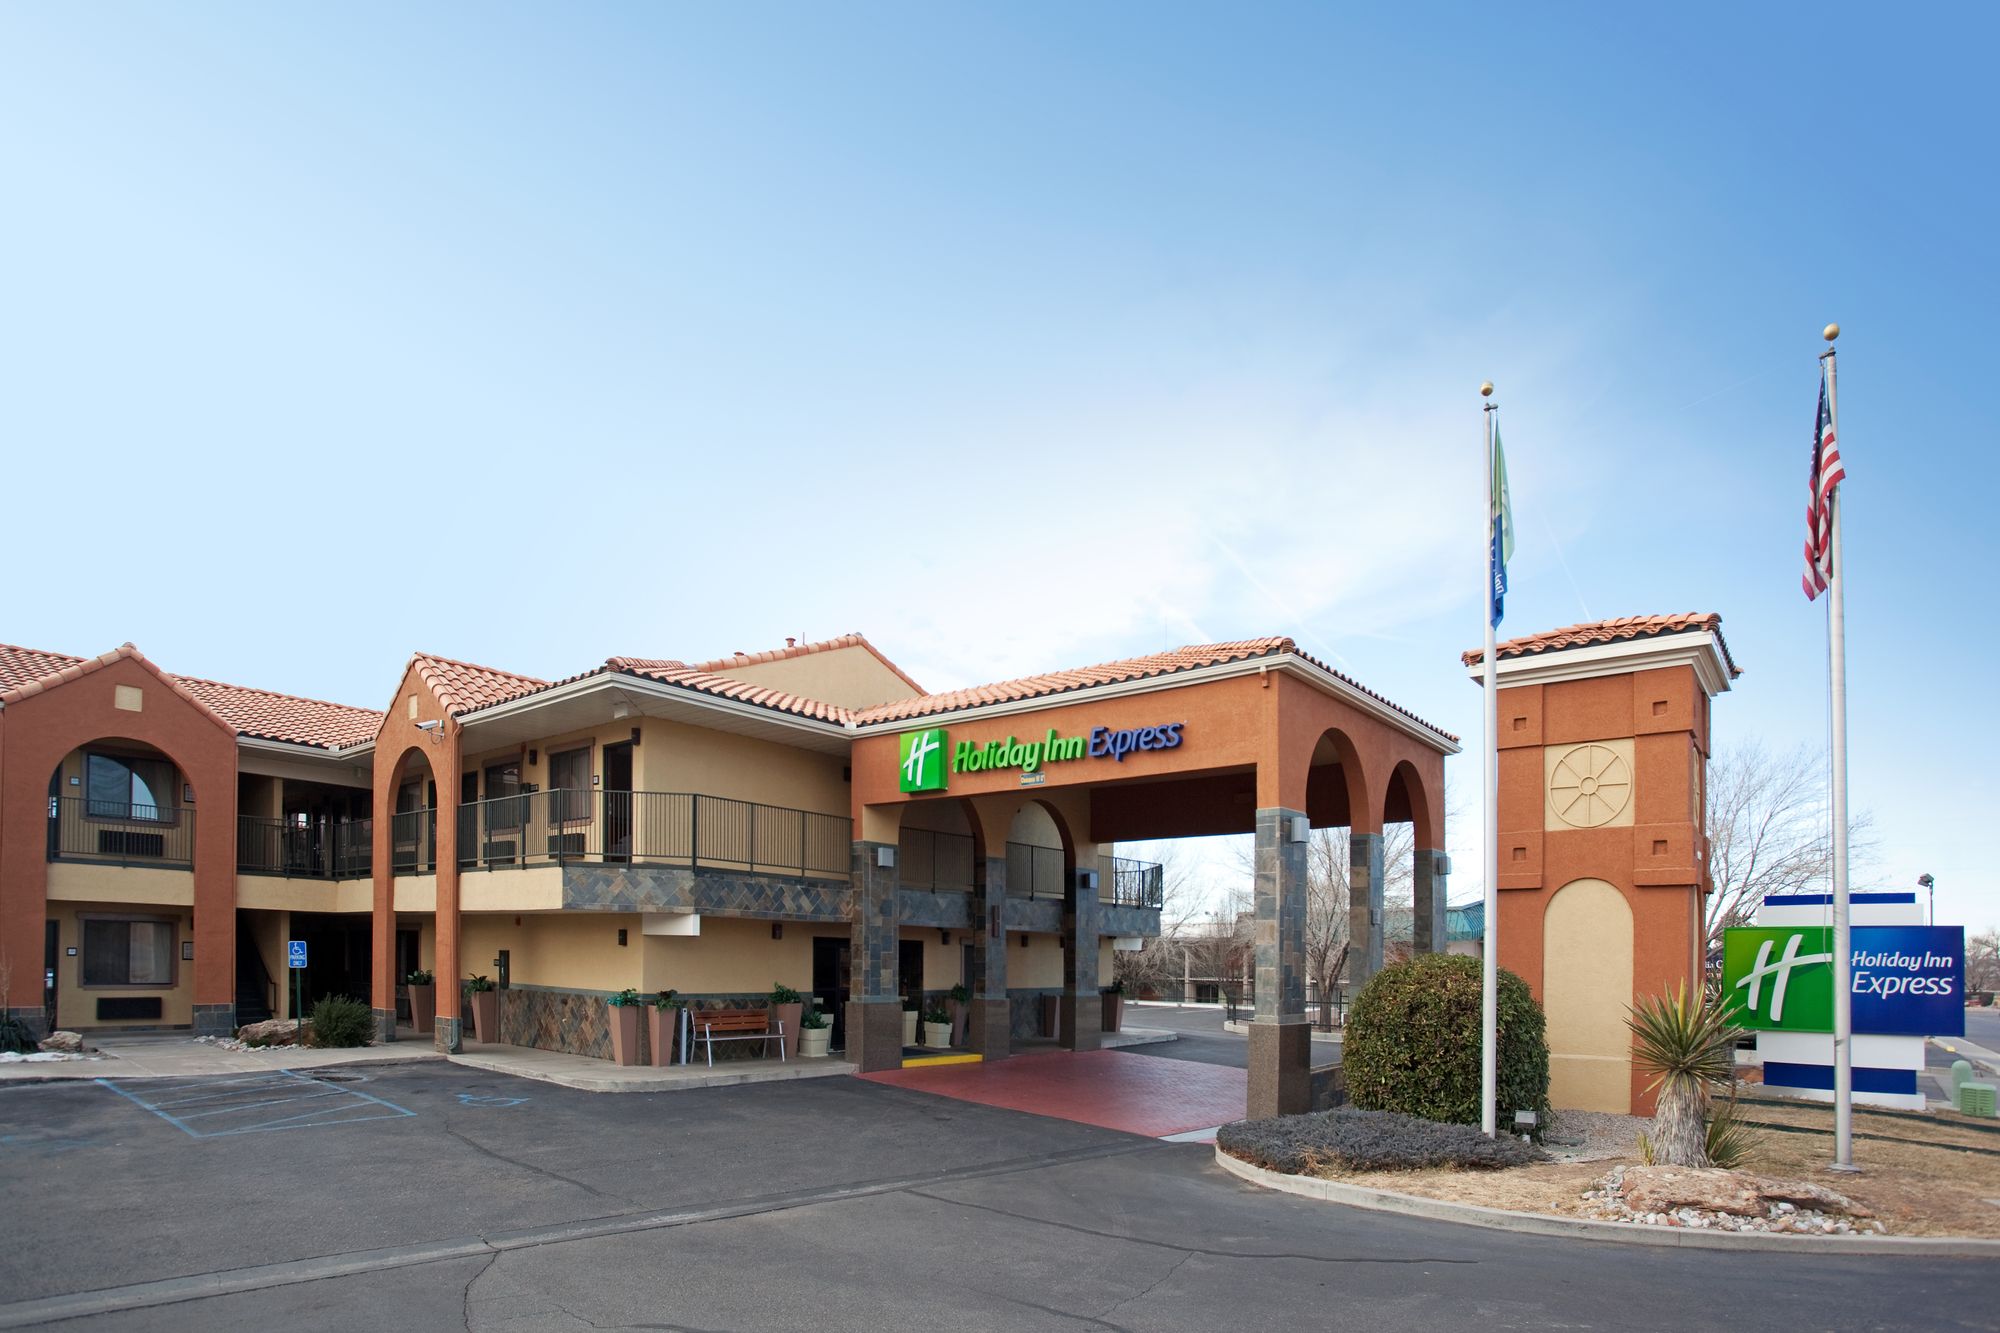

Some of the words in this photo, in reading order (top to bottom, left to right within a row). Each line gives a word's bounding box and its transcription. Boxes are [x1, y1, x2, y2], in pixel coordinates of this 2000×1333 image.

[952, 735, 1044, 774] Holiday
[1043, 728, 1088, 763] Inn
[1088, 722, 1185, 762] Express
[1851, 950, 1922, 971] Holiday
[1923, 951, 1953, 968] Inn
[1851, 971, 1953, 999] Express
